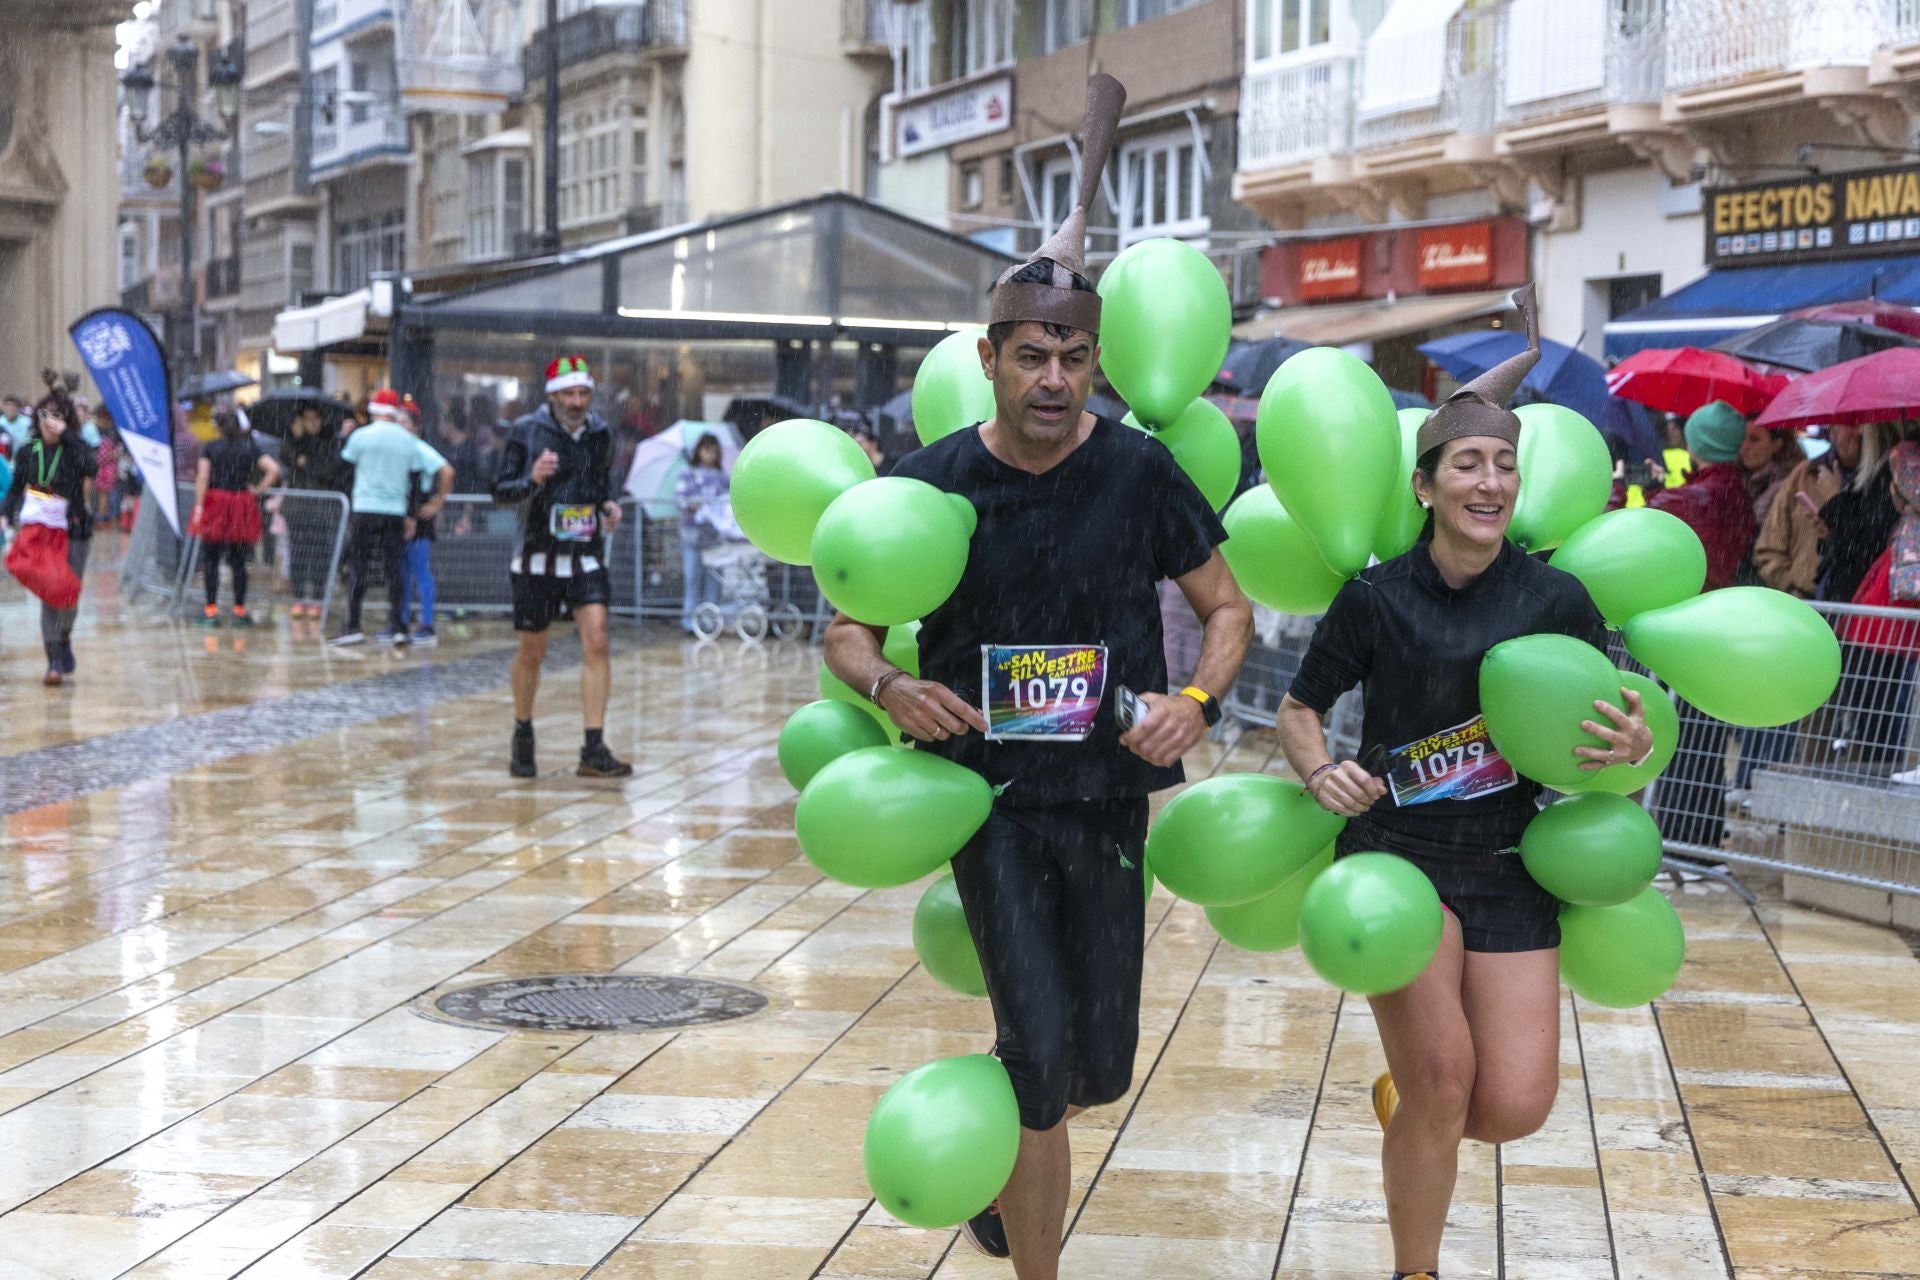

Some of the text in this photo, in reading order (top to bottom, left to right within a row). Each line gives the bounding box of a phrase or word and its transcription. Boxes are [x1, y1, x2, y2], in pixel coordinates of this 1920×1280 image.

[1713, 171, 1920, 234] EFECTOS NAVA
[1011, 650, 1046, 668] SAN
[1011, 649, 1096, 681] SILVESTRE
[1049, 662, 1096, 678] CARTAGENA
[1009, 677, 1088, 709] 1079
[1445, 729, 1488, 750] CARTAGEN
[1410, 741, 1485, 783] 1079
